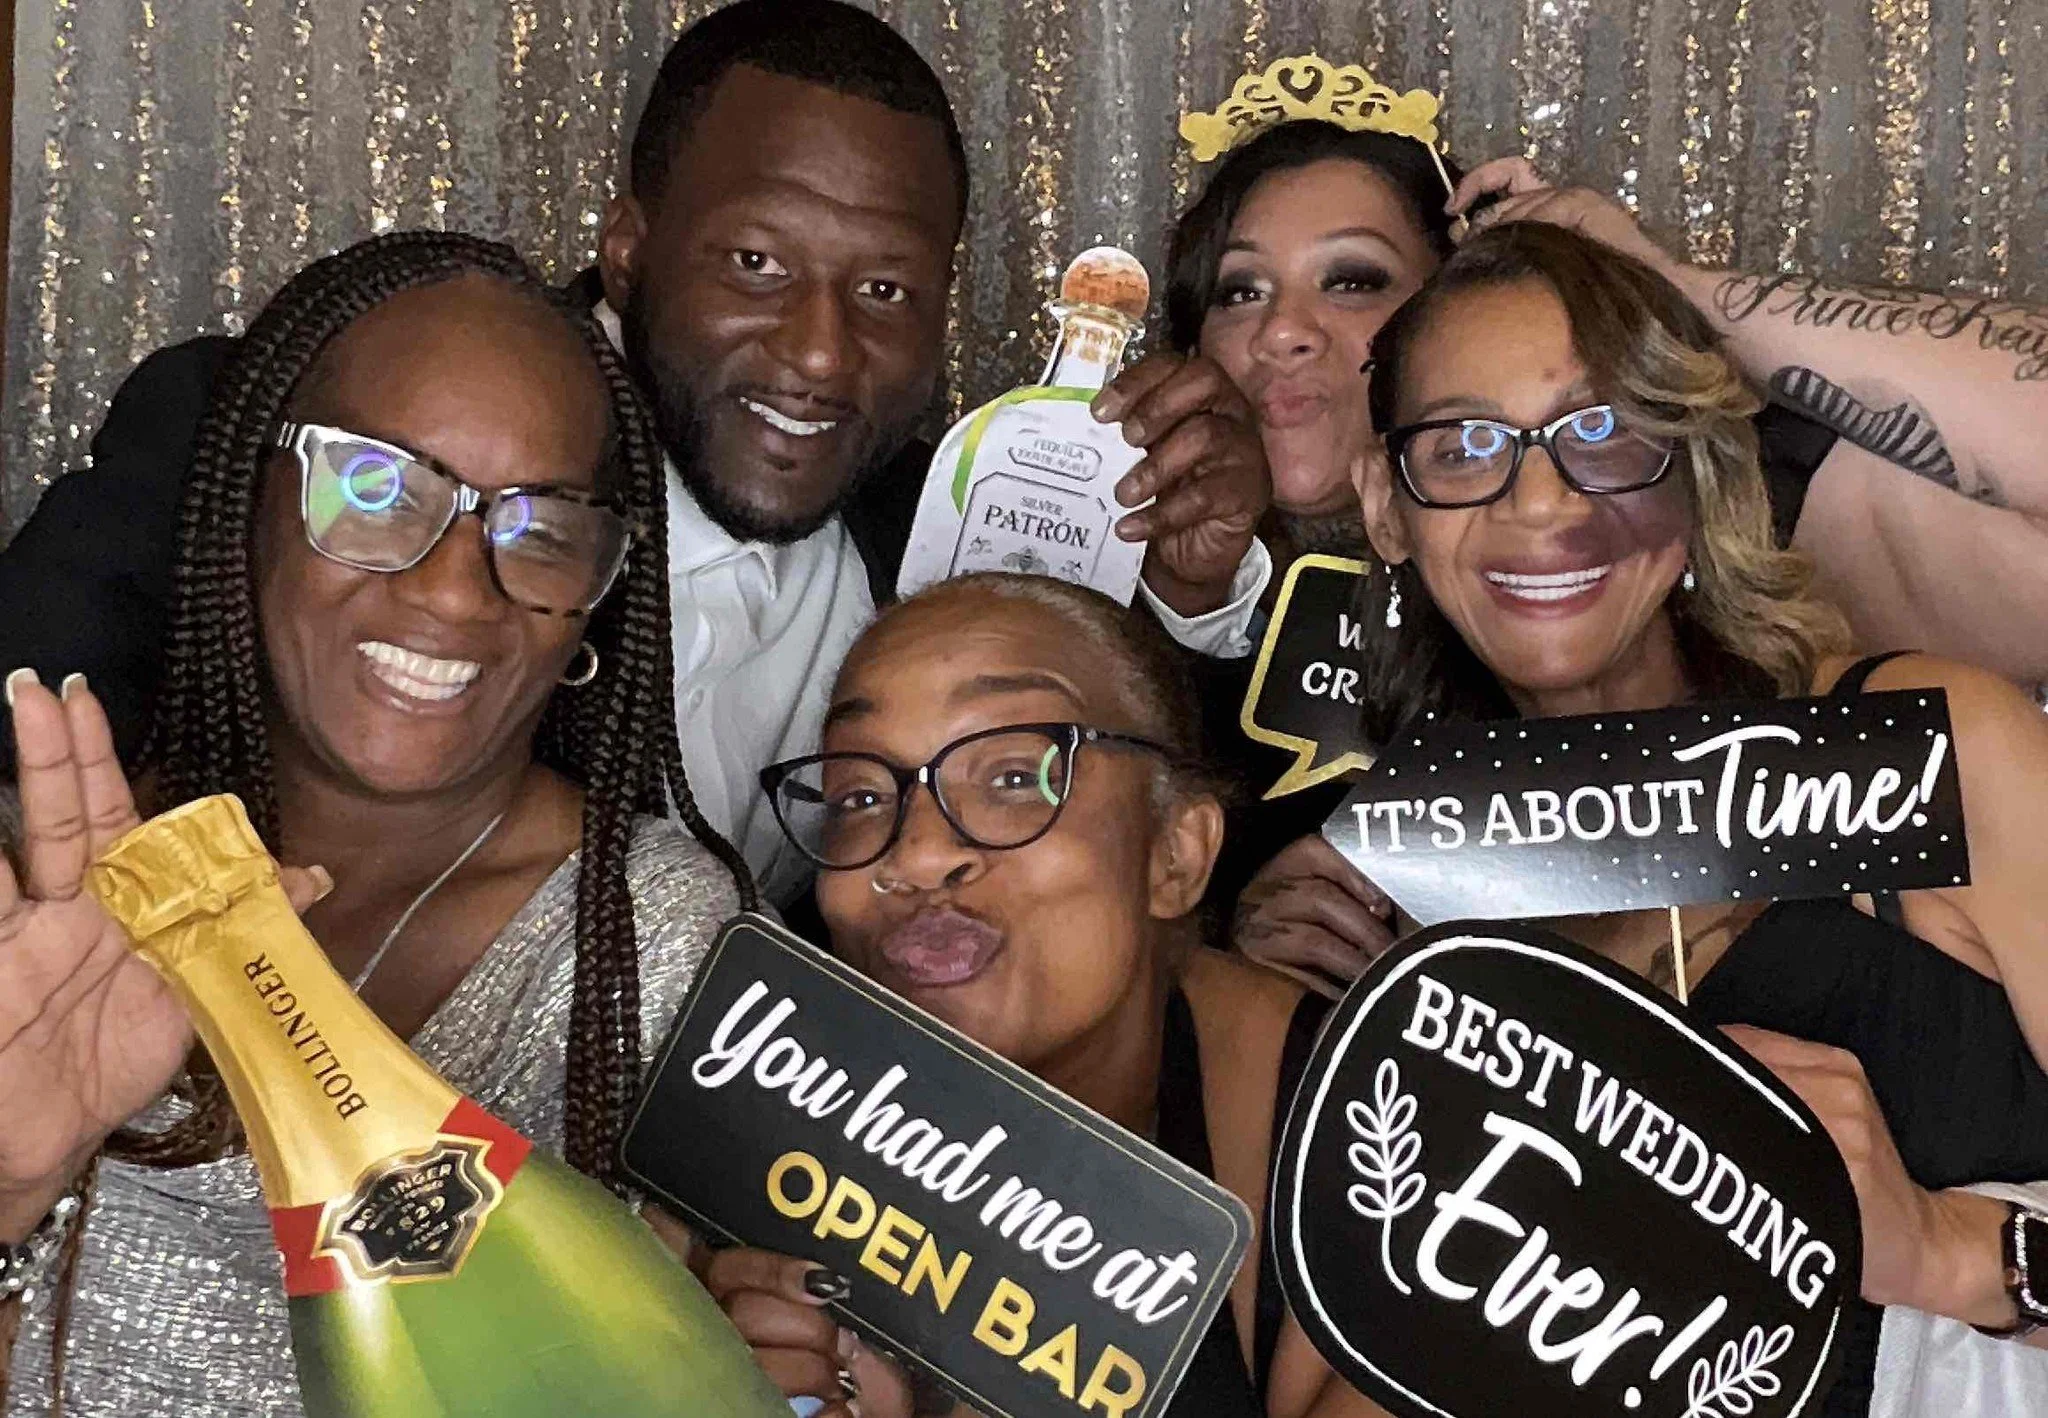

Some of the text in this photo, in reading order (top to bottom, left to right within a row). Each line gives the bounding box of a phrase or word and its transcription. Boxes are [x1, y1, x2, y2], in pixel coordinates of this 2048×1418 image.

[1020, 495, 1063, 516] SILVER
[1301, 661, 1361, 705] CR
[1351, 724, 1948, 854] IT'S ABOUT Time!
[243, 951, 369, 1121] BOLLINGER
[1401, 974, 1838, 1310] BEST WEDDING
[691, 979, 1199, 1325] You had me at
[1415, 1110, 1729, 1409] Ever!
[765, 1150, 1147, 1418] OPEN BAR
